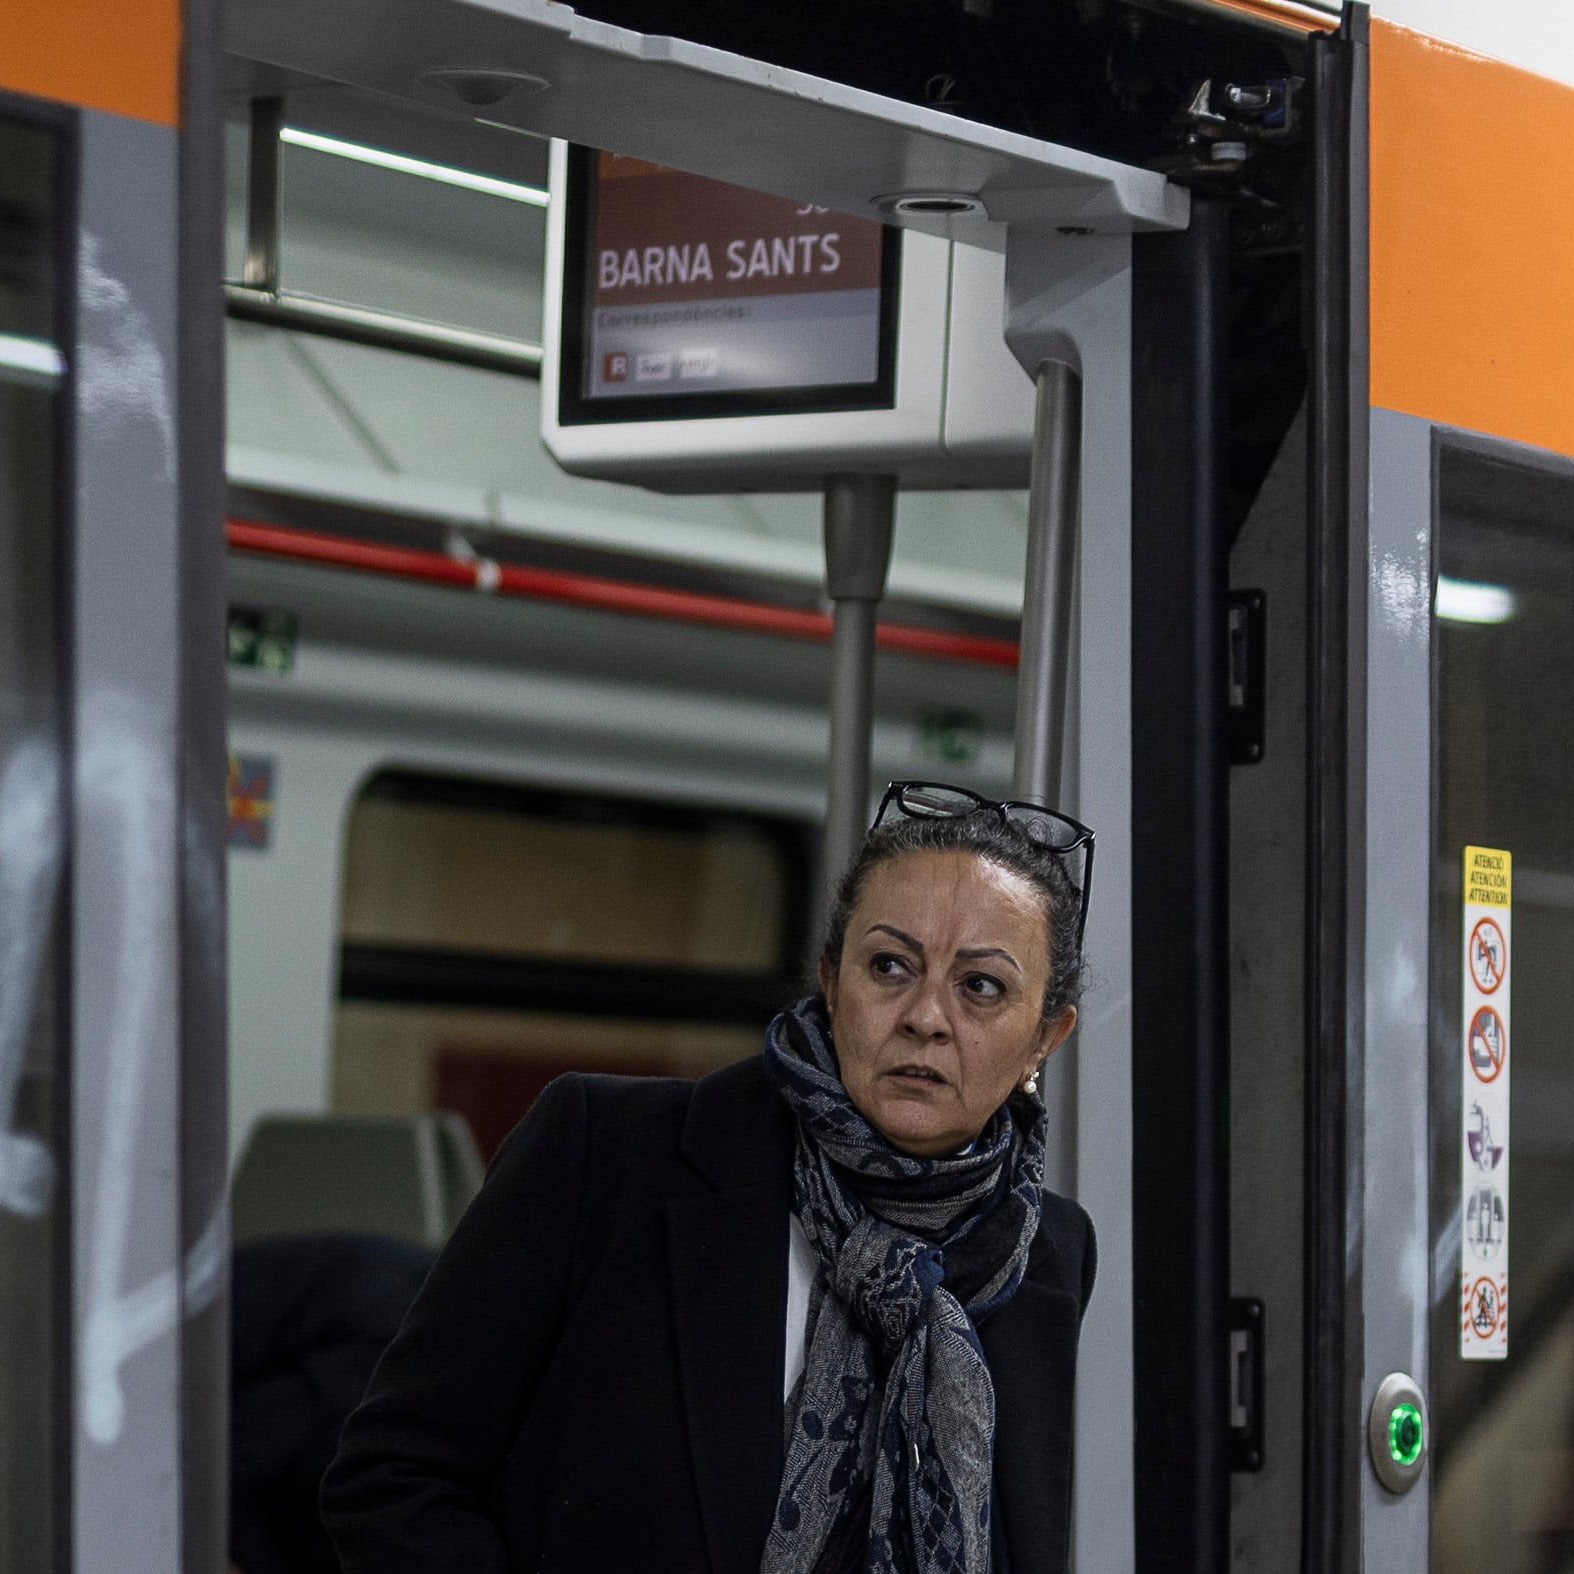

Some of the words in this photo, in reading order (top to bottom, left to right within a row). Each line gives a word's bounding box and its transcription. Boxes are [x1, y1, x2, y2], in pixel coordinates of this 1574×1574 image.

[599, 243, 713, 289] BARNA
[726, 233, 840, 280] SANTS
[1474, 853, 1505, 870] ATENCIÓ
[1469, 888, 1508, 905] ATTENTION
